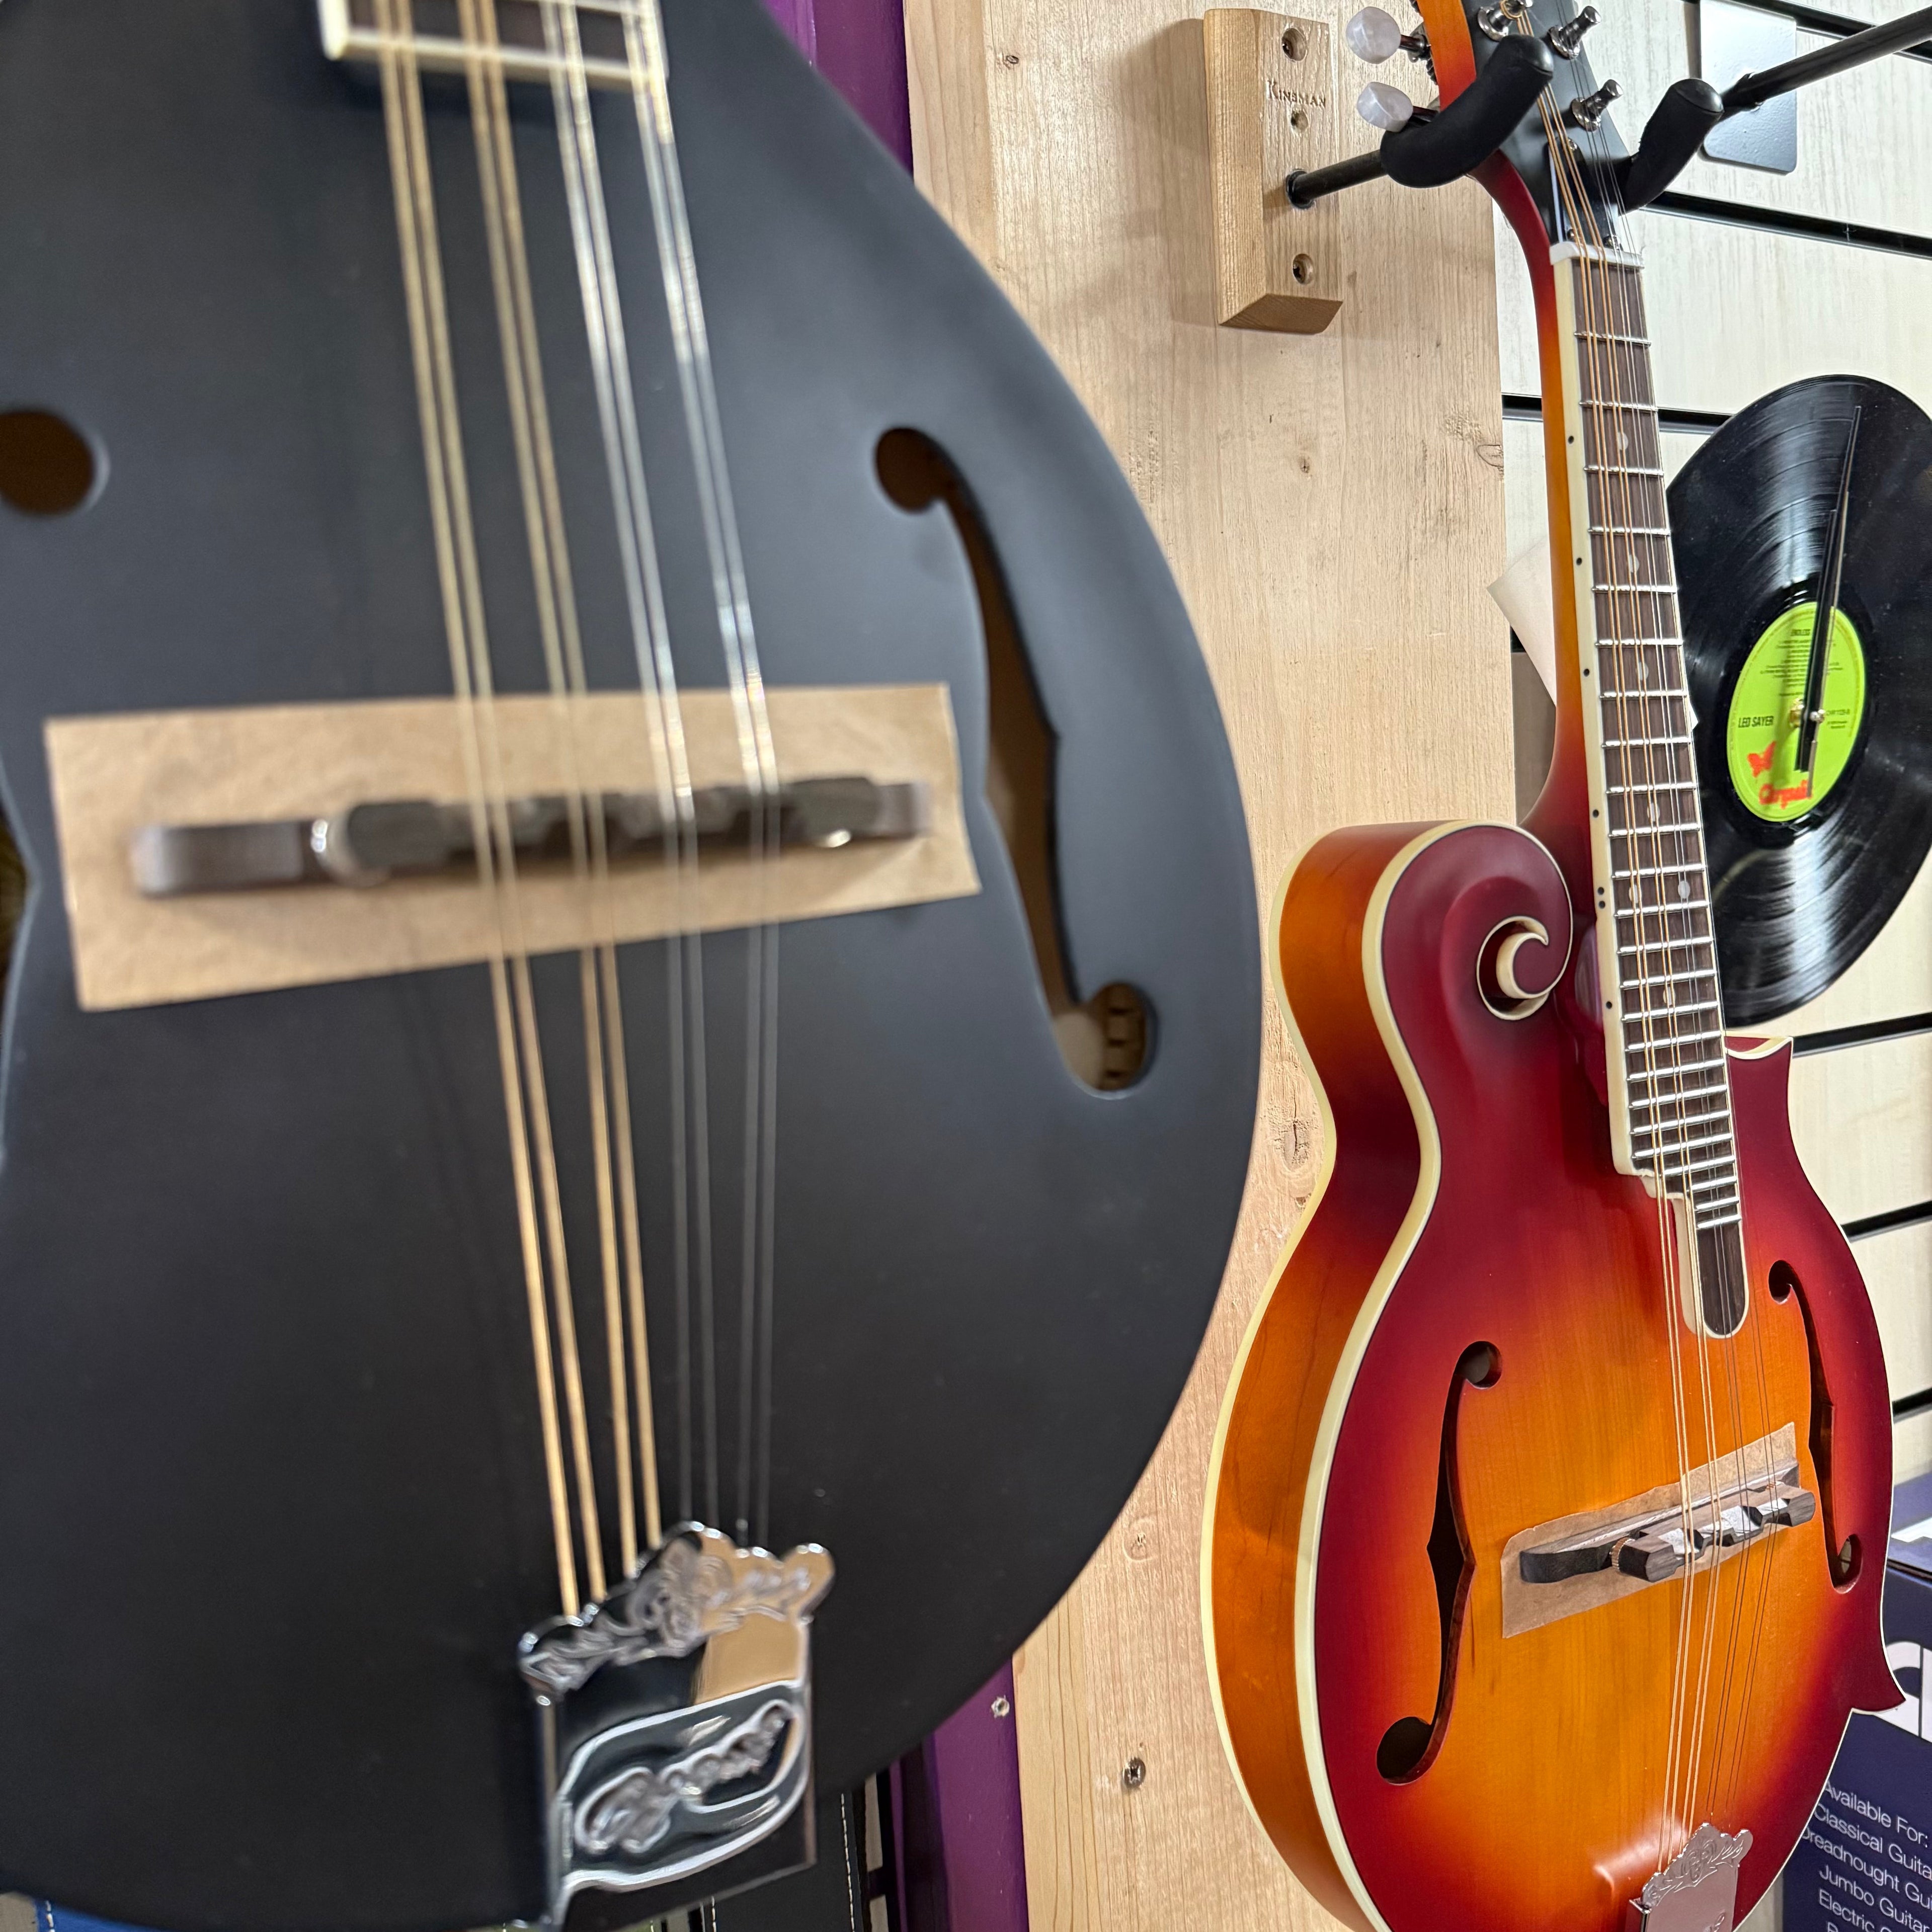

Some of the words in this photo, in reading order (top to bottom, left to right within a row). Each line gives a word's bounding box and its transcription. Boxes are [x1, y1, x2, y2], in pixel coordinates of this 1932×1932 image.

[1738, 717, 1750, 728] LEO
[1752, 716, 1774, 727] SAYER
[1814, 1803, 1882, 1853] Classical
[1825, 1781, 1891, 1827] Available
[1897, 1815, 1928, 1847] For:
[1819, 1864, 1874, 1906] Jumbo
[1880, 1897, 1930, 1932] Guitar
[1819, 1888, 1875, 1931] Electric
